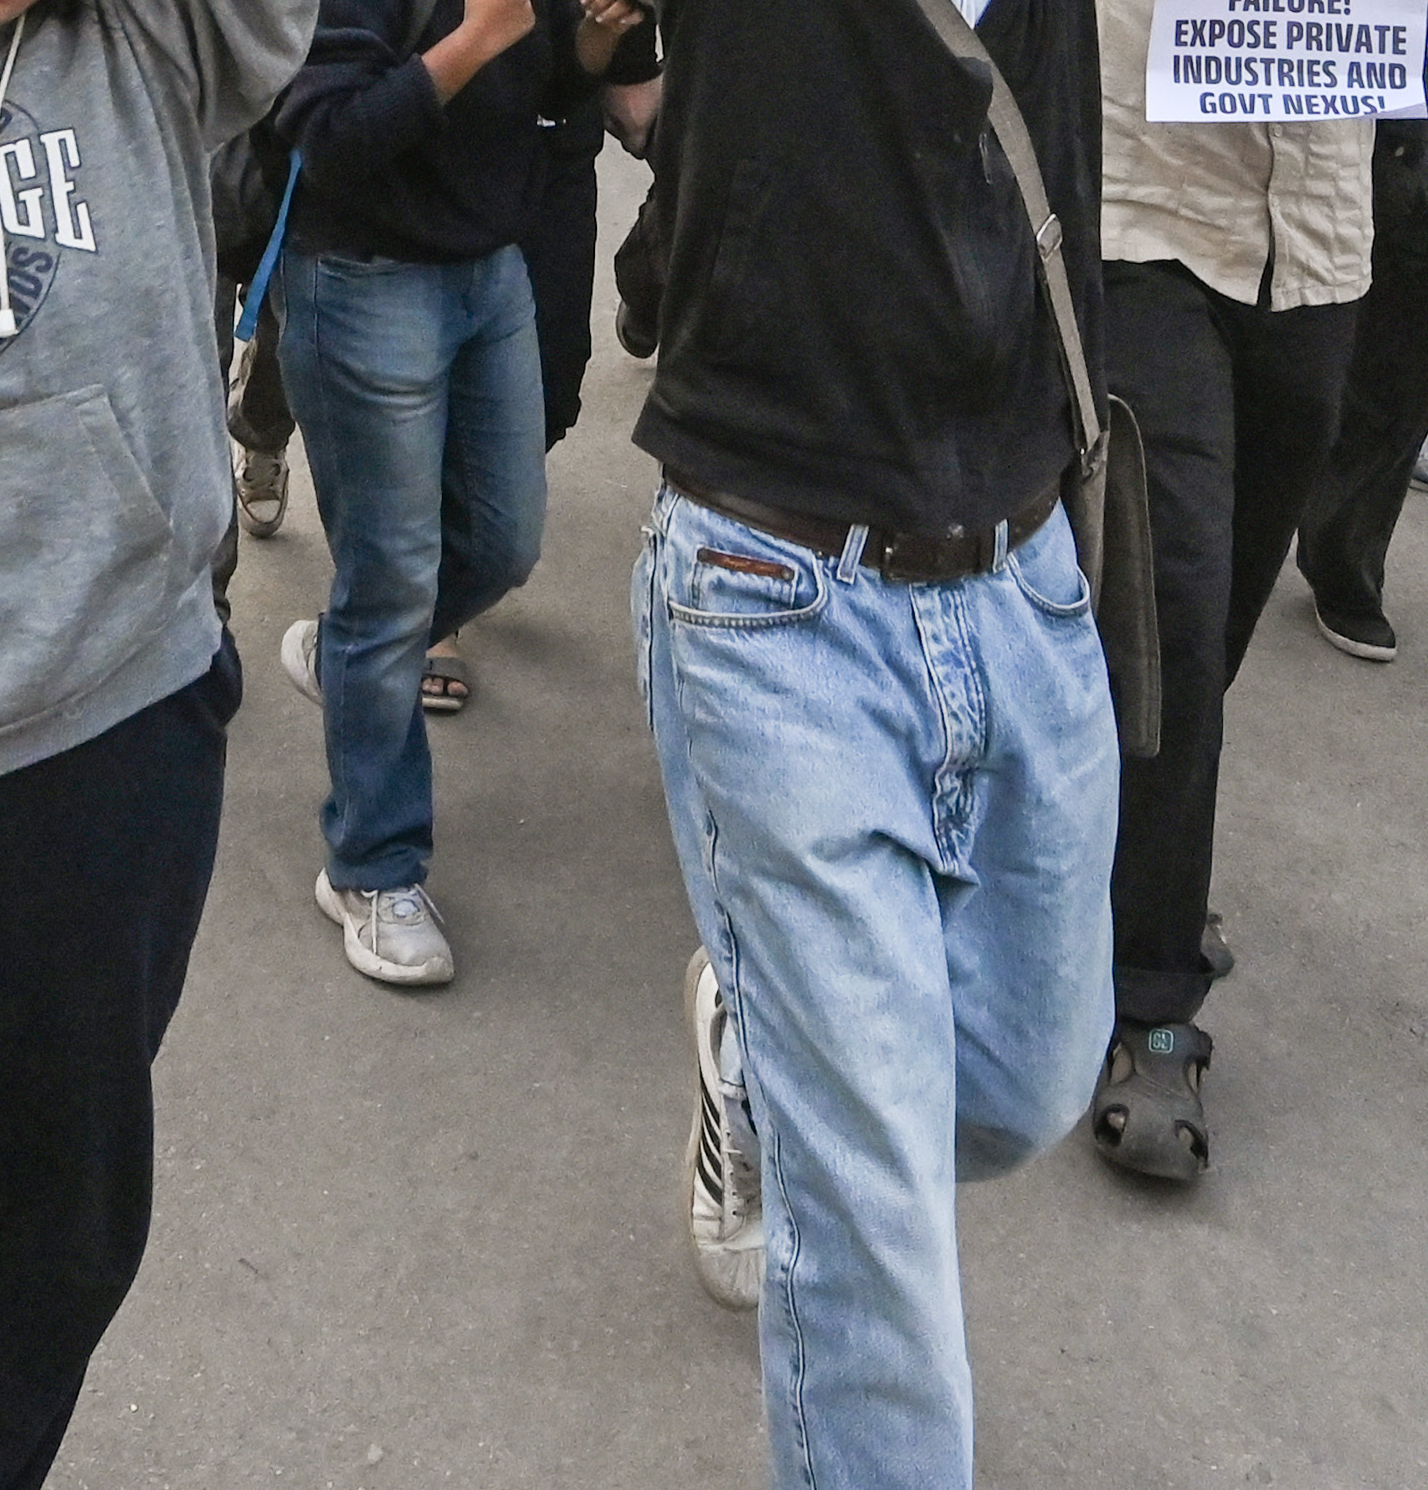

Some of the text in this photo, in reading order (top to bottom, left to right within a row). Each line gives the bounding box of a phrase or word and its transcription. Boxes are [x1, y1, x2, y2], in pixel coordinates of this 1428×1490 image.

[1175, 19, 1407, 55] EXPOSE PRIVATE
[1173, 55, 1407, 89] INDUSTRIES AND
[1200, 92, 1273, 114] GOVT
